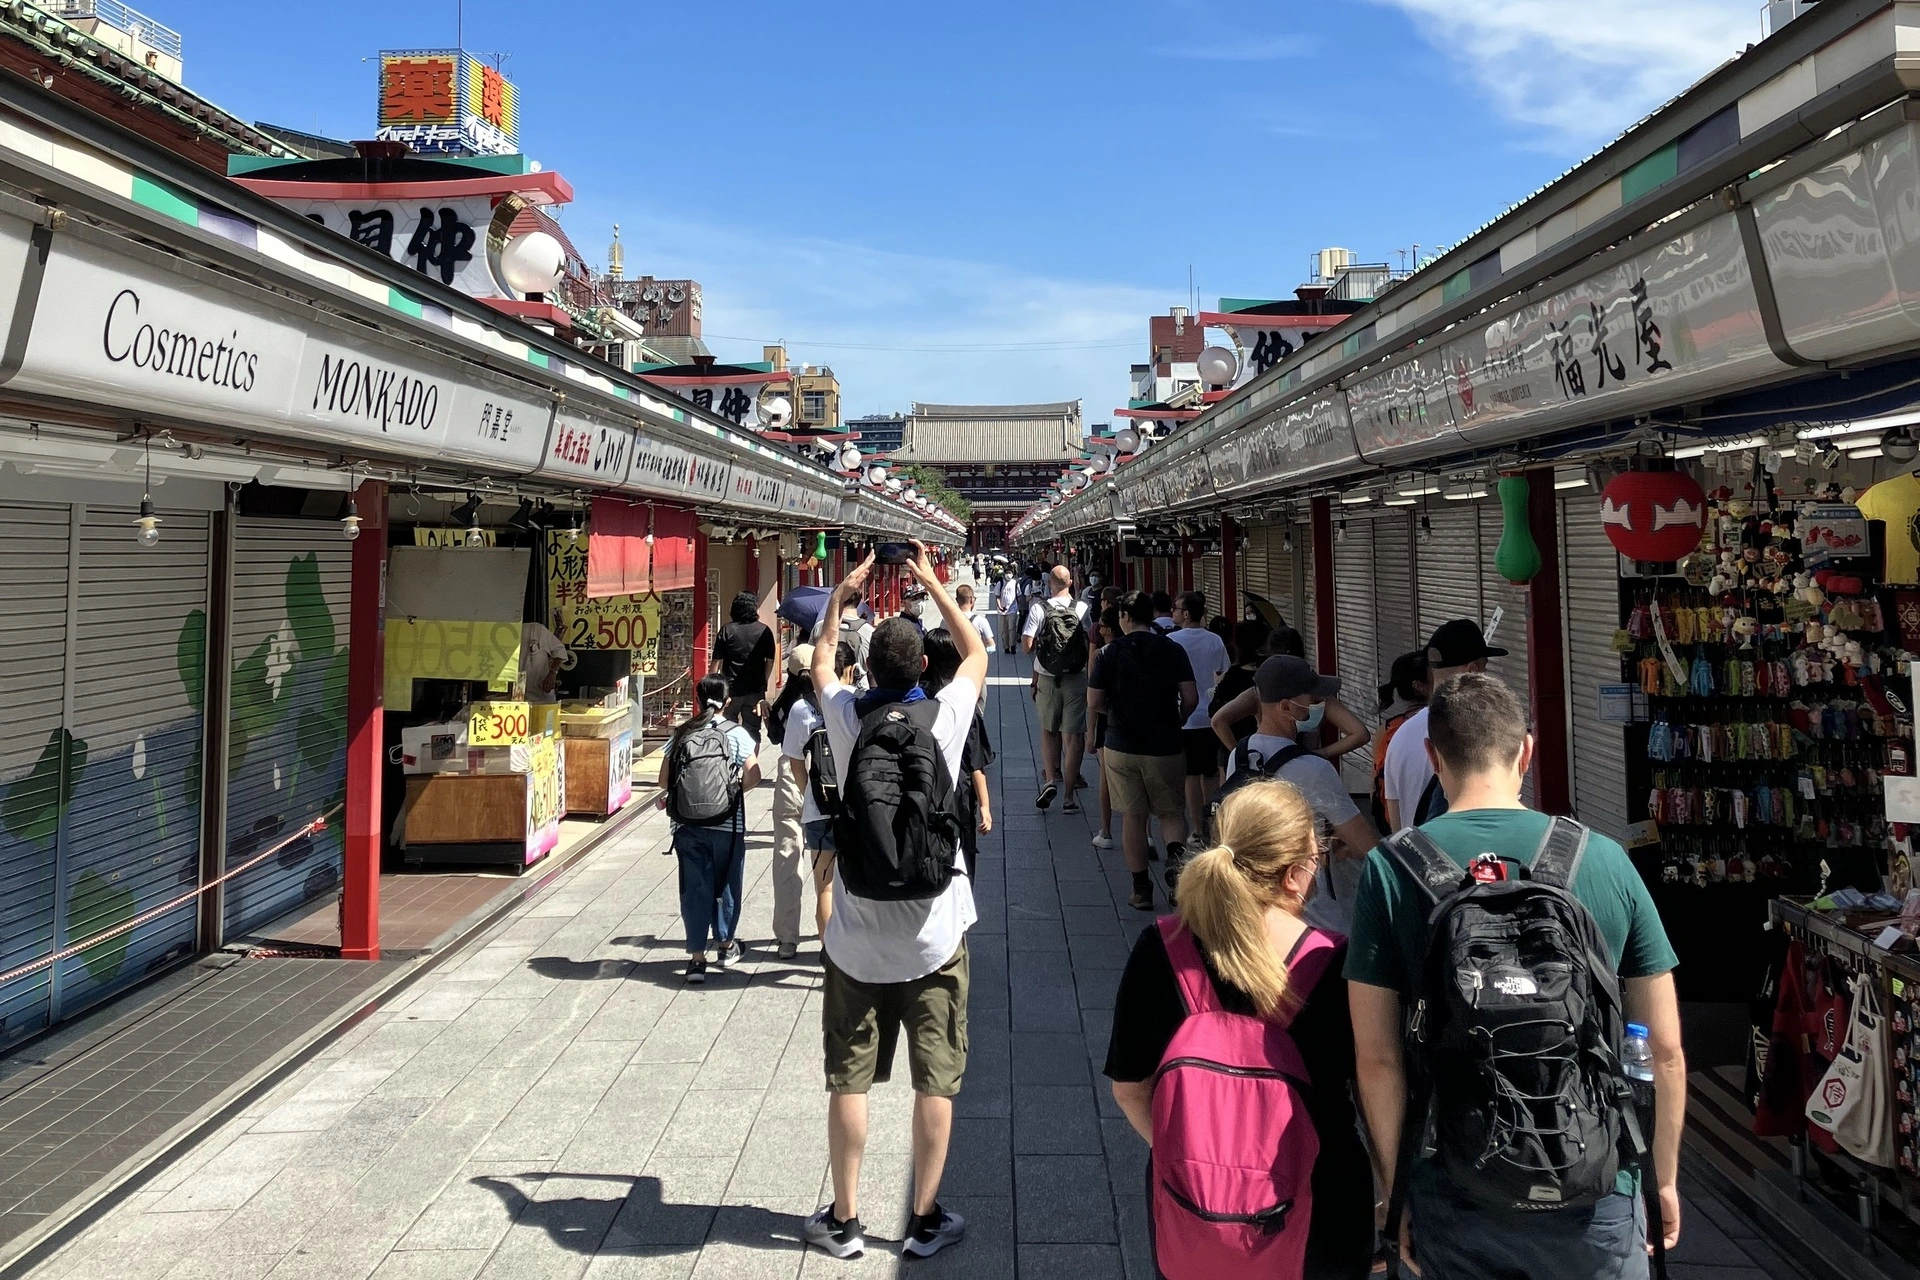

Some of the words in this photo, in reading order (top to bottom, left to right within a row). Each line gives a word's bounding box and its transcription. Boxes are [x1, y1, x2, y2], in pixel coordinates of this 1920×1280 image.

[385, 60, 453, 119] 薬
[482, 65, 504, 127] 薬
[103, 289, 258, 392] Cosmetics
[313, 353, 438, 433] MONKADO
[478, 403, 513, 442] 門嘉堂
[630, 661, 657, 674] サービス
[511, 736, 526, 745] えん
